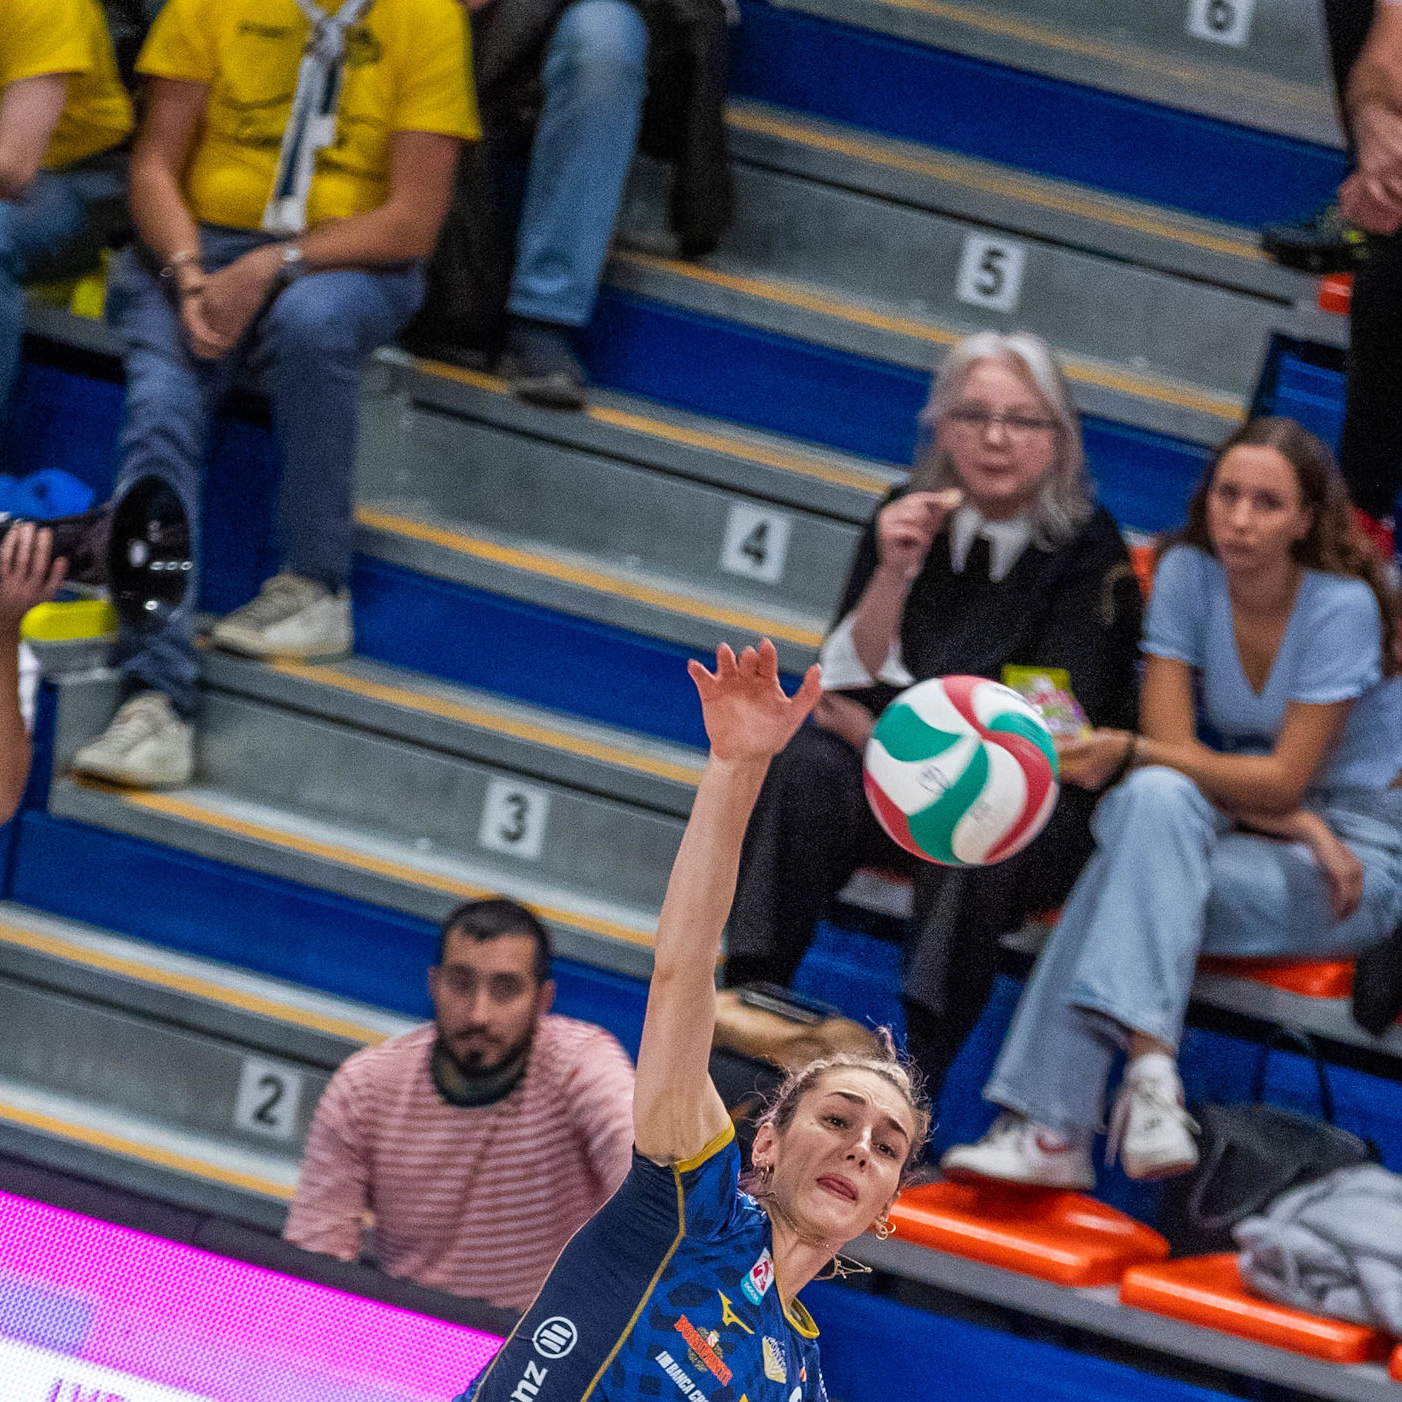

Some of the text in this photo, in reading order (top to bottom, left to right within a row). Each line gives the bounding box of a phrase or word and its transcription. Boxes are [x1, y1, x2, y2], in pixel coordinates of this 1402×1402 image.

[975, 250, 1006, 297] 5
[739, 522, 769, 567] 4
[499, 794, 528, 843] 3
[253, 1073, 285, 1126] 2
[666, 1361, 695, 1394] BANCA
